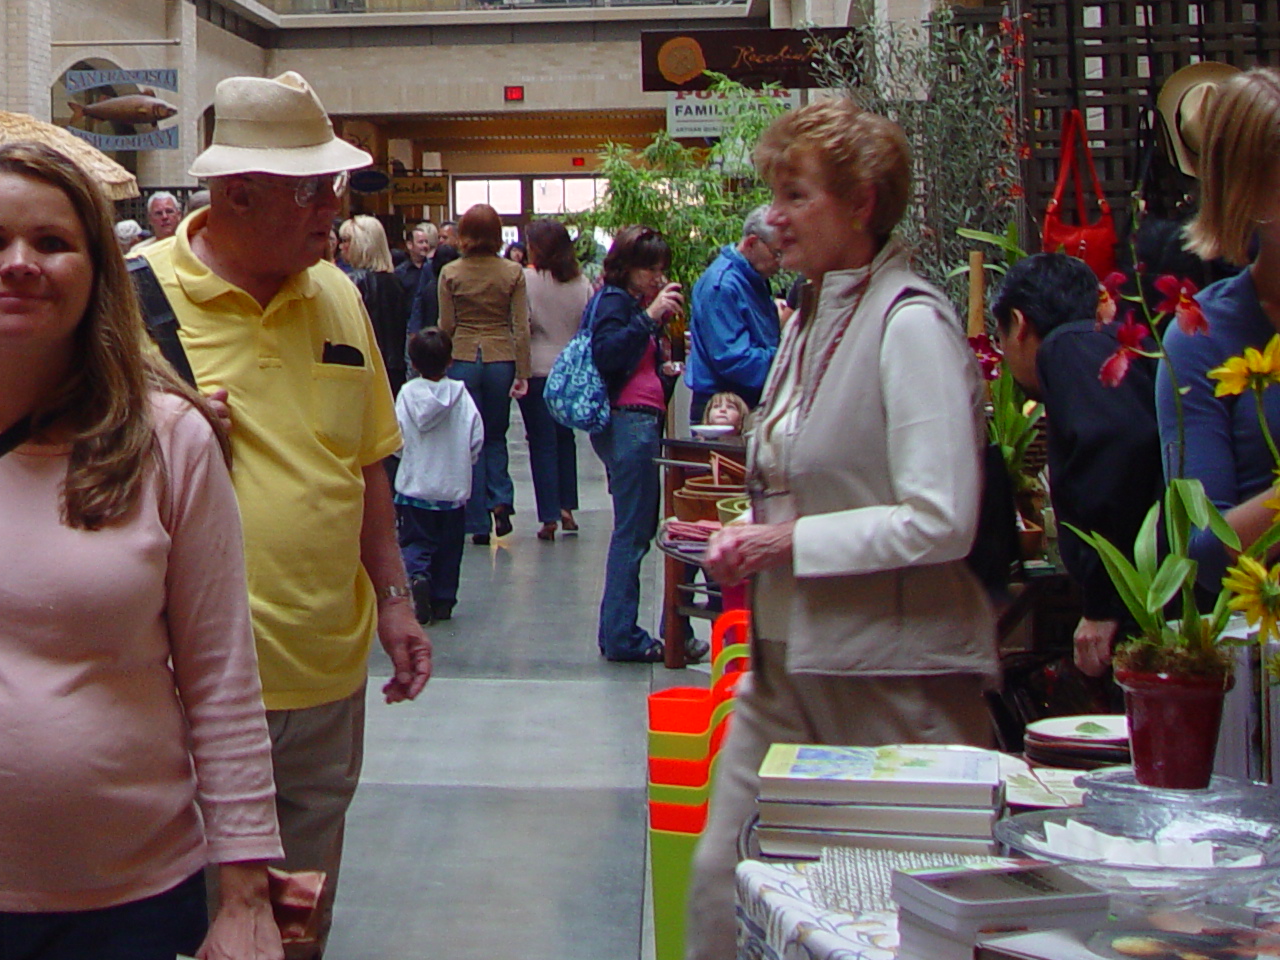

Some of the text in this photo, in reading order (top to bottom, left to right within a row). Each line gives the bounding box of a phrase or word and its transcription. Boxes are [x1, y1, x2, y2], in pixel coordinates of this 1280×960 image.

[68, 67, 178, 91] SAN FRANCISCO
[675, 103, 729, 117] FAMILY
[105, 128, 174, 148] COMPANY
